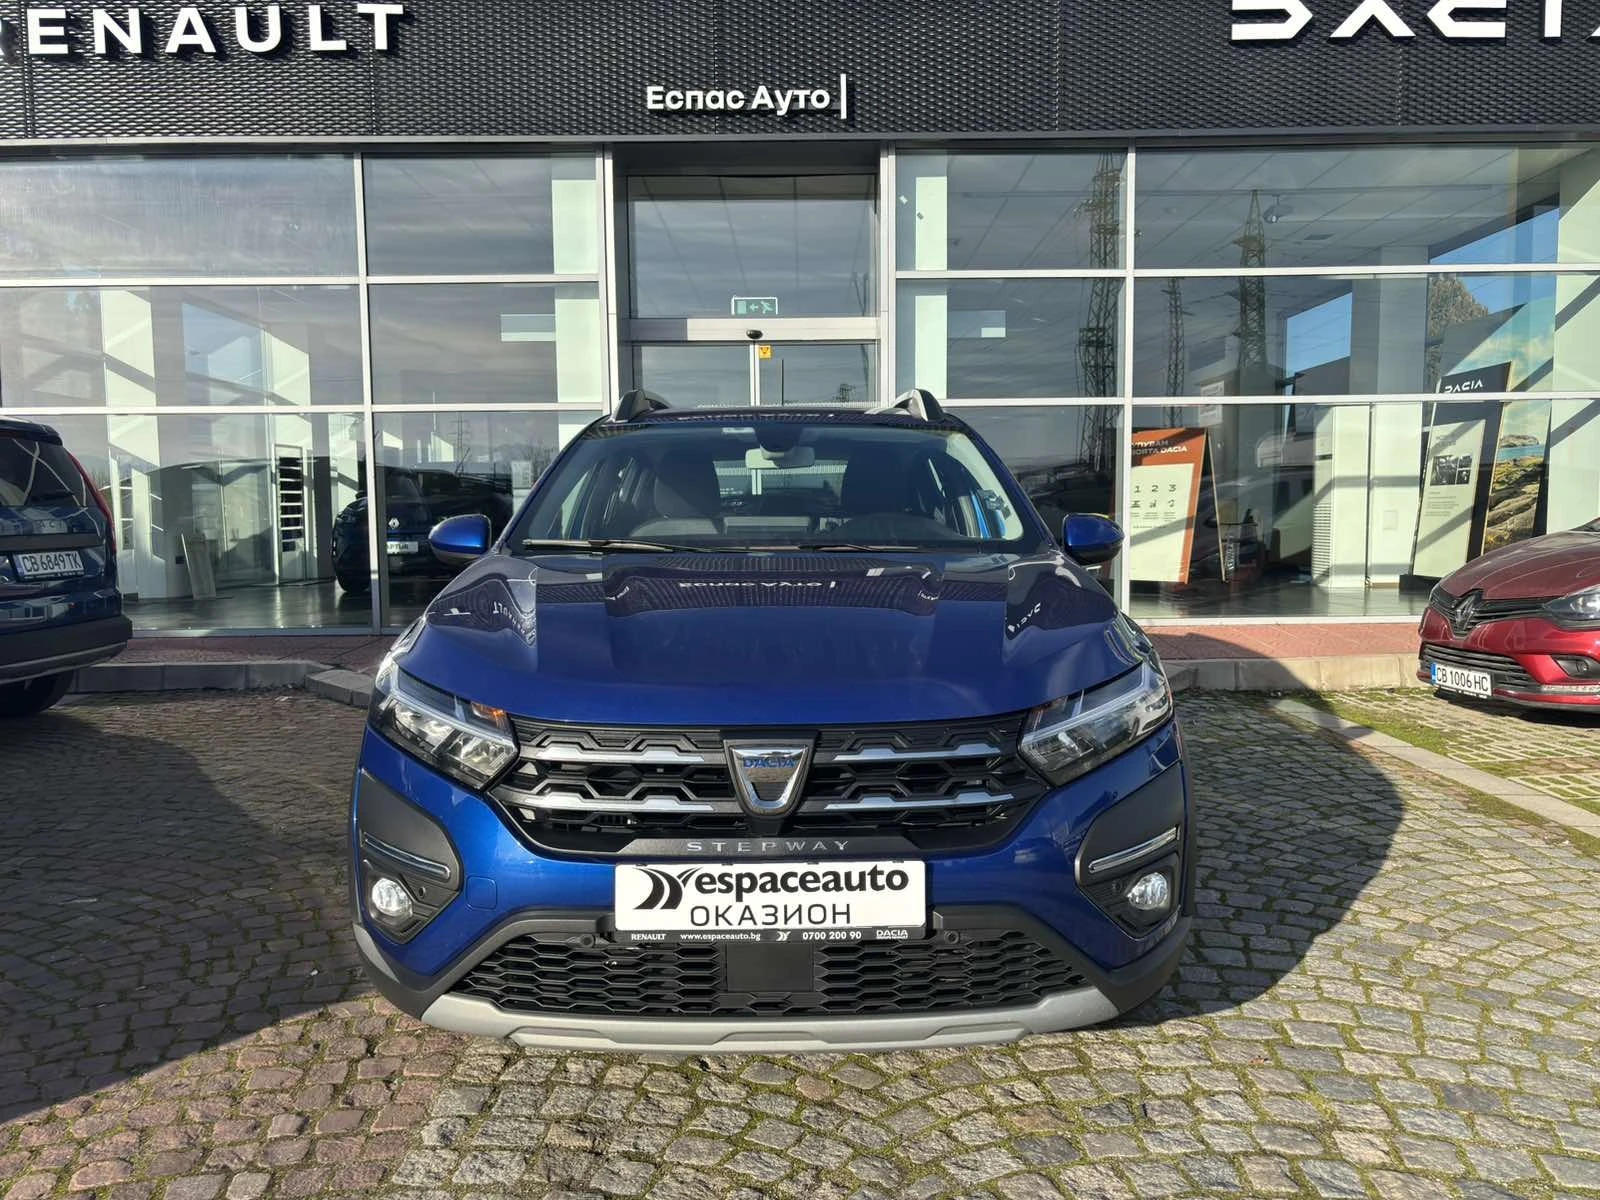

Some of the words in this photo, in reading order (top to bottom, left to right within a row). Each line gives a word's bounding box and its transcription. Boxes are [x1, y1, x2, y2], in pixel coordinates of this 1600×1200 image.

[0, 4, 404, 55] ENAULT
[1232, 0, 1600, 40] DACI
[646, 86, 745, 110] Еспас
[751, 86, 830, 116] Ауто
[1444, 379, 1484, 394] DACIA
[1160, 445, 1188, 454] DACIA
[1134, 485, 1141, 493] 1
[1151, 484, 1159, 493] 2
[1168, 484, 1176, 493] 3
[22, 555, 39, 572] CB
[40, 553, 66, 570] 6849
[66, 552, 81, 569] TK
[1436, 667, 1447, 683] CB
[1450, 670, 1472, 688] 1006
[1474, 674, 1488, 691] HC
[743, 757, 797, 769] DACIA
[687, 840, 849, 852] STEPWAY
[694, 864, 910, 902] espaceauto
[690, 903, 851, 927] ОКАЗИОН
[680, 932, 761, 942] www.espaceauto.bg
[802, 931, 826, 940] 0700
[829, 930, 847, 940] 200
[849, 930, 862, 939] 90
[876, 929, 908, 938] DACIA
